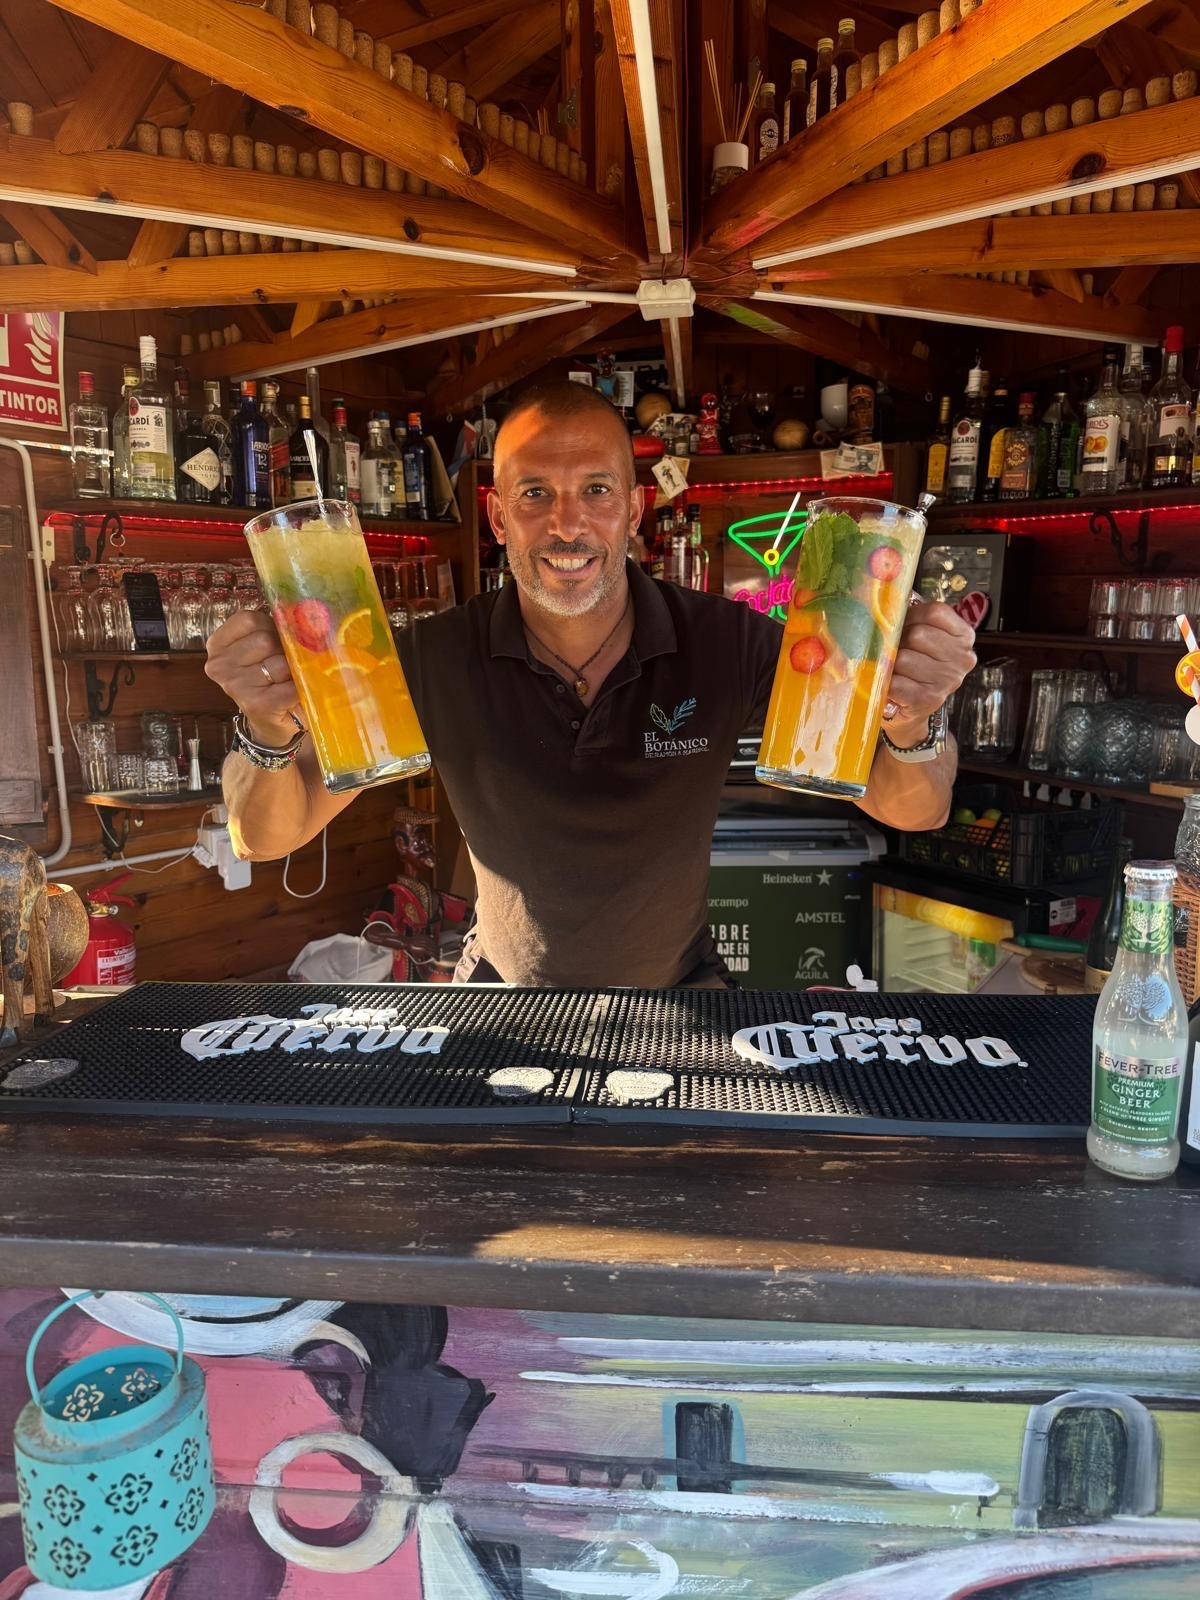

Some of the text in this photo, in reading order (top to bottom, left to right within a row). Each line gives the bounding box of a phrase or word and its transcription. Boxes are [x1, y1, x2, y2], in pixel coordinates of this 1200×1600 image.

[255, 452, 267, 466] 12
[644, 732, 659, 742] EL
[645, 738, 708, 753] BOTÁNICO
[762, 873, 813, 884] Heineken
[708, 898, 749, 908] zcampo
[795, 912, 846, 923] AMSTEL
[737, 943, 749, 955] EN
[1098, 1051, 1178, 1075] FEVER-TREE
[1118, 1076, 1155, 1088] PREMIUM
[1111, 1083, 1160, 1099] GINGER
[1119, 1096, 1151, 1109] BEER
